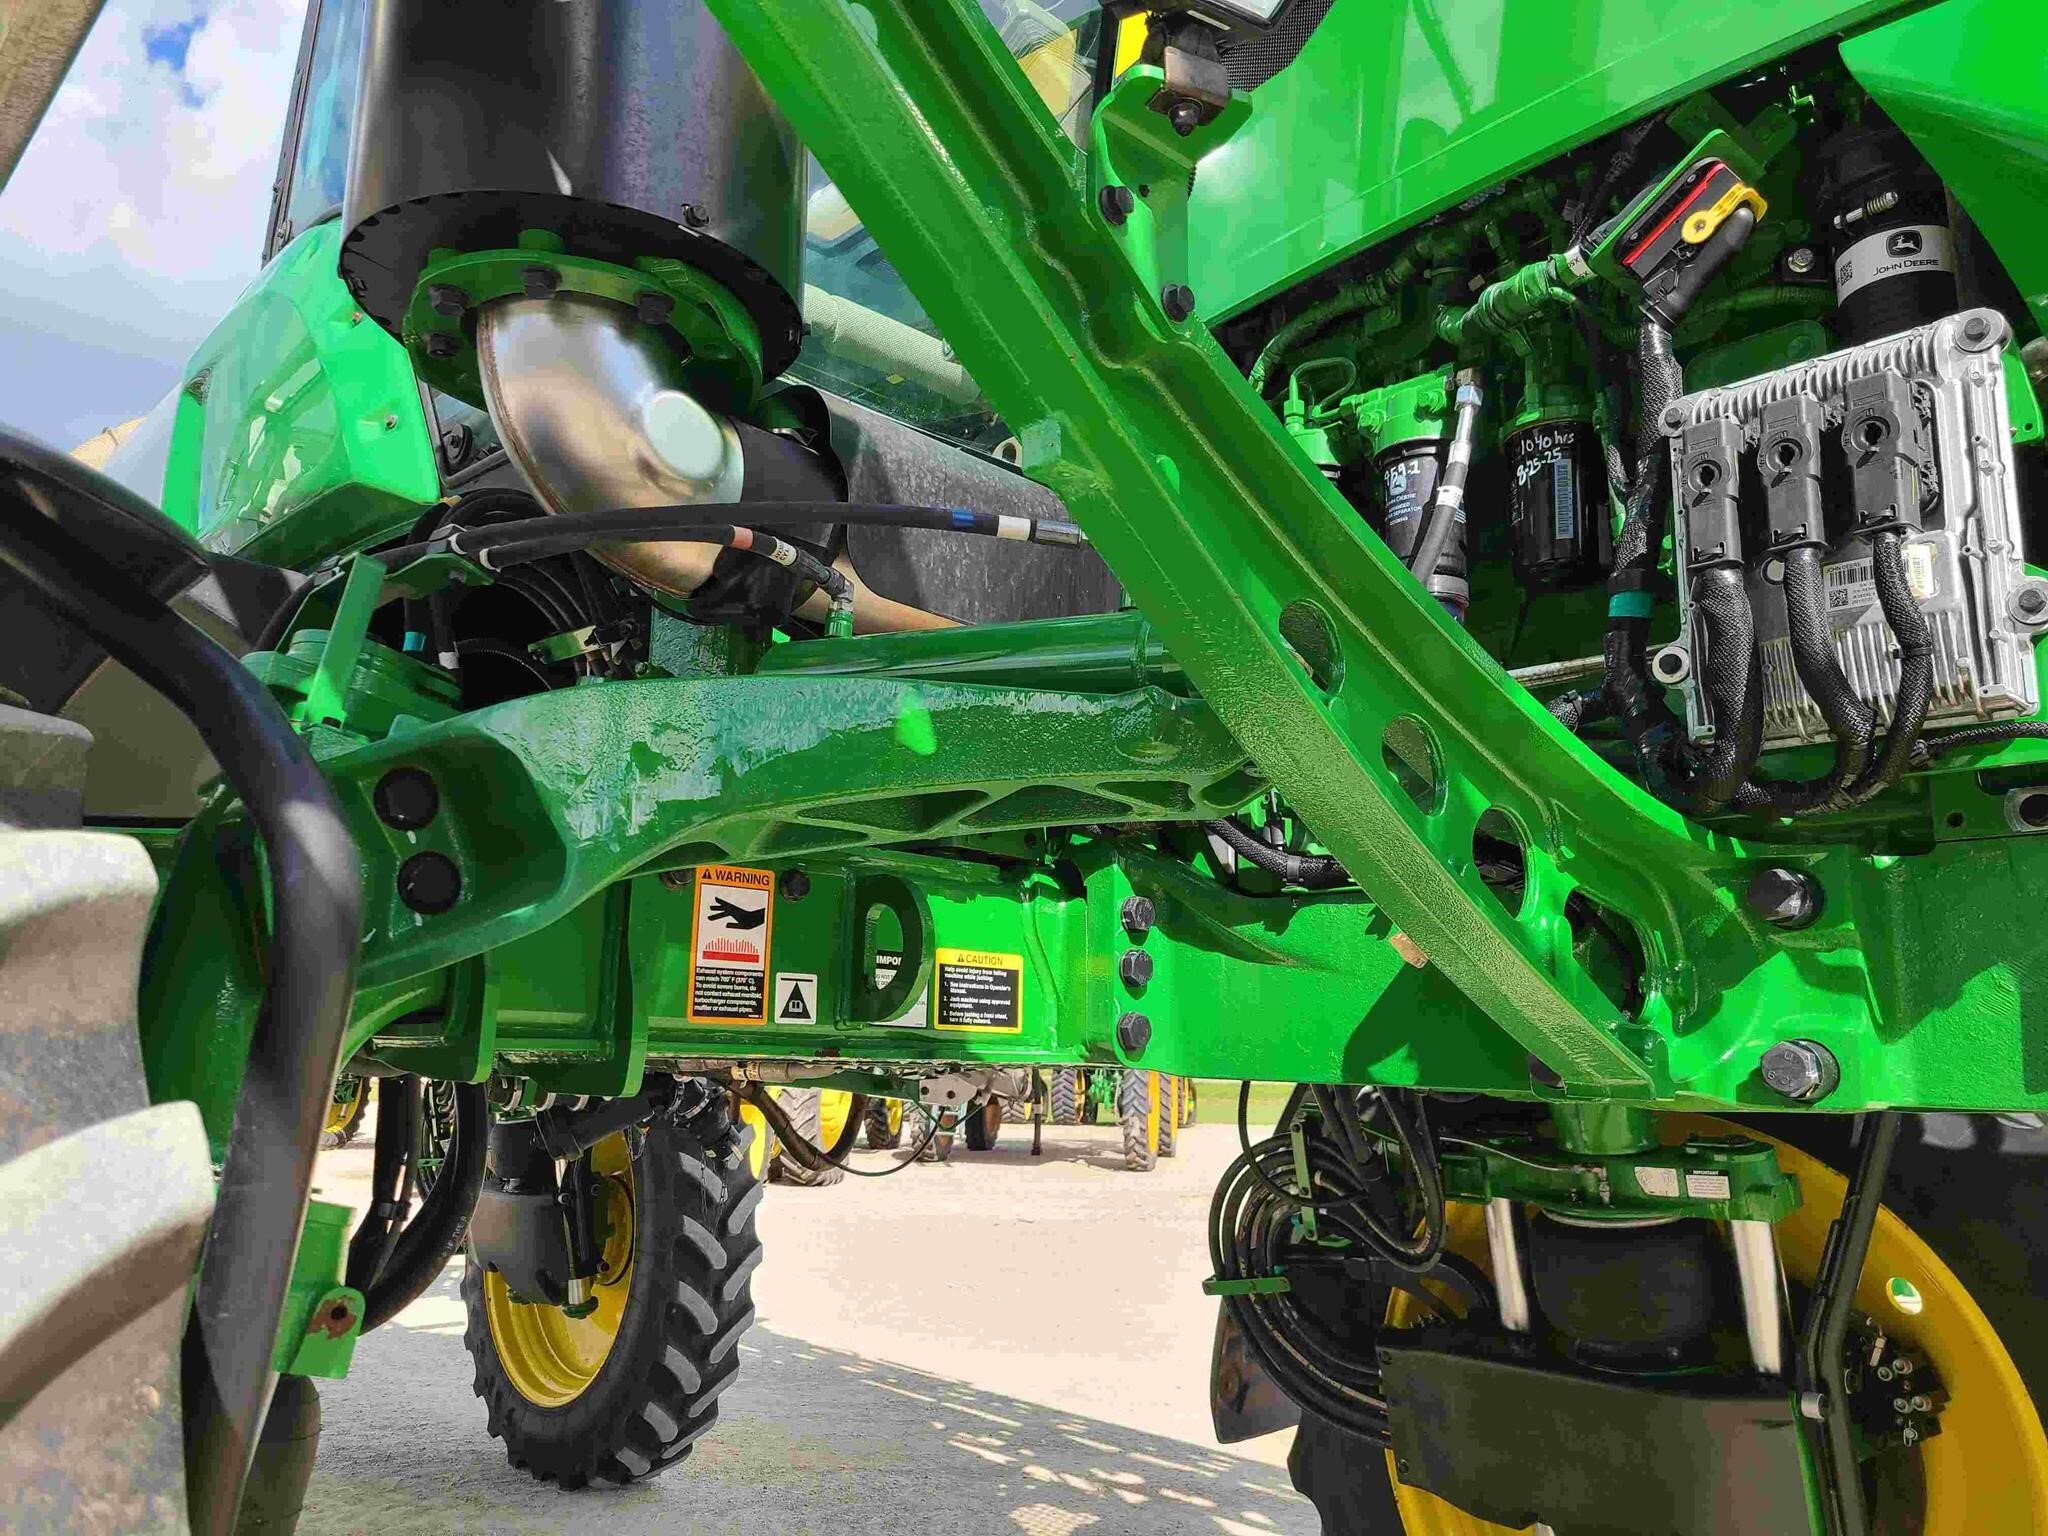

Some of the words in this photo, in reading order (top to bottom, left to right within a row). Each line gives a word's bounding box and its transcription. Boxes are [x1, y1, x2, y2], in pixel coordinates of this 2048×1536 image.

[1873, 263, 1902, 276] JOHN
[715, 869, 770, 886] WARNING
[966, 954, 1003, 966] CAUTION
